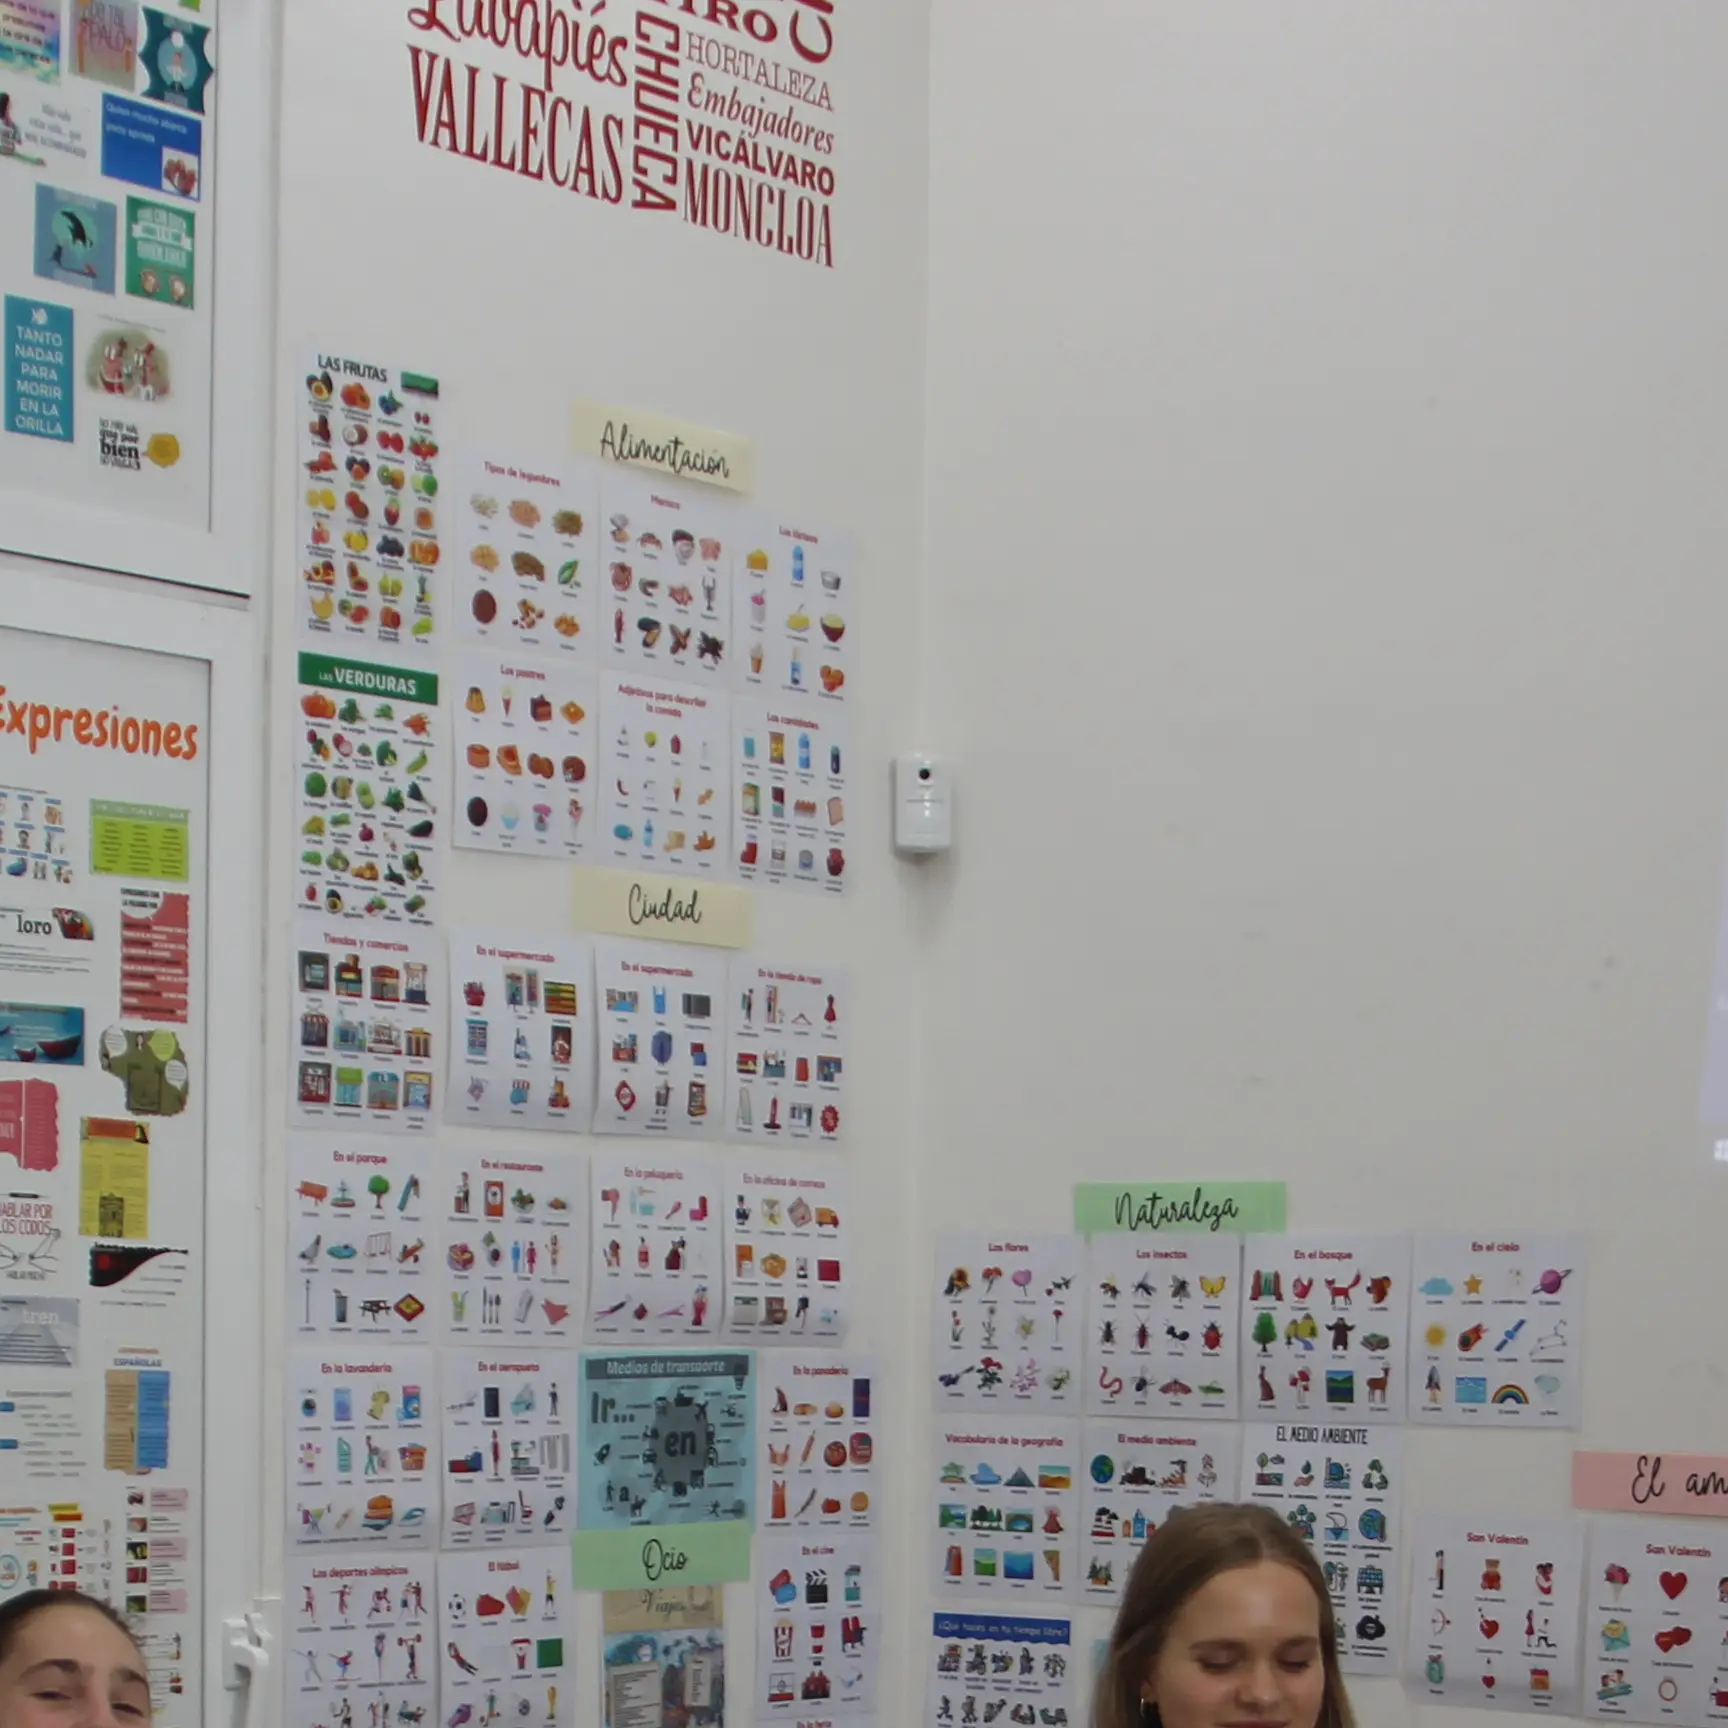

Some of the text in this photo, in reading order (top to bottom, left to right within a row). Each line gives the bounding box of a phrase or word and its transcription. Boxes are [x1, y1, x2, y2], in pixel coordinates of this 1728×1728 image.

[686, 31, 834, 111] HORTALEZA
[632, 10, 679, 212] CHUECA
[686, 72, 835, 155] Embajadores
[407, 43, 623, 205] VALLECAS
[686, 119, 835, 196] VICÁLVARO
[683, 157, 834, 268] MONCLOA
[16, 325, 62, 347] TANTO
[15, 343, 63, 365] NADAR
[21, 362, 58, 381] PARA
[318, 354, 388, 383] LAS FRUTAS
[16, 380, 62, 400] MORIR
[20, 398, 59, 417] EN LA
[15, 416, 63, 436] ORILLA
[100, 440, 140, 459] bien
[600, 421, 730, 479] Alimentación
[319, 666, 417, 695] LAS VERDURAS
[628, 883, 702, 925] Ciudad
[17, 914, 52, 934] loro
[334, 1152, 388, 1166] En el parque
[34, 1204, 53, 1219] POR
[1115, 1187, 1239, 1231] Naturaleza
[1152, 1250, 1188, 1260] insectos
[1294, 1250, 1354, 1262] En el bosque
[1472, 1242, 1520, 1253] En el cielo
[320, 1364, 332, 1374] En
[334, 1363, 344, 1374] la
[607, 1360, 648, 1374] Medios
[650, 1360, 665, 1374] de
[664, 1430, 696, 1456] en
[946, 1434, 996, 1445] Vocabulario
[998, 1436, 1010, 1446] de
[1010, 1436, 1020, 1446] la
[1126, 1434, 1154, 1445] medio
[1156, 1436, 1196, 1448] ambiente
[1276, 1426, 1368, 1445] EL MEDIO AMBIENTE
[1631, 1455, 1666, 1503] El
[1466, 1532, 1528, 1546] San Valentín
[642, 1539, 688, 1580] Ocio
[1646, 1544, 1712, 1558] San Valentín
[328, 1568, 368, 1579] deportes
